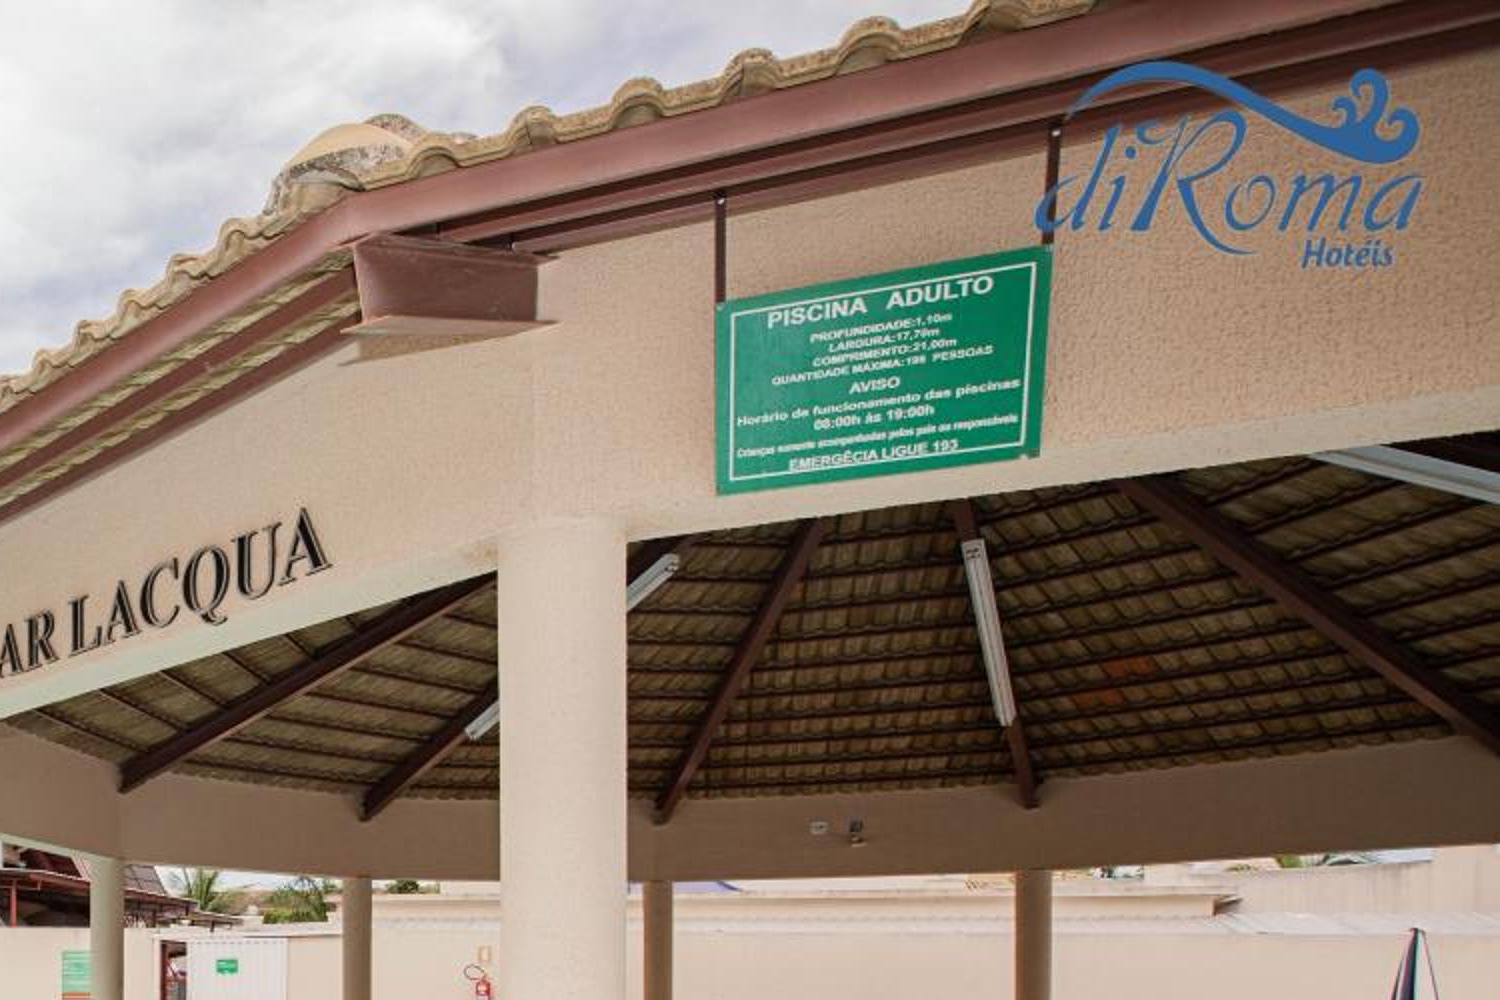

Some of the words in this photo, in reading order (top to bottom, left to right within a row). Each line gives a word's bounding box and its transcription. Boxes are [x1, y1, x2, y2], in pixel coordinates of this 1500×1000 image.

[768, 297, 867, 328] PISCINA
[886, 276, 994, 310] ADULTO
[772, 366, 850, 385] QUANTIDADE
[932, 345, 994, 363] PESSOAS
[850, 376, 900, 394] AVISO
[737, 412, 788, 427] Horário
[813, 392, 921, 415] funcionamento
[924, 388, 951, 400] das
[955, 378, 1021, 398] piscinas
[886, 404, 935, 421] 19:00h
[789, 448, 878, 473] EMERGÊCIA
[882, 441, 928, 460] LIGUE
[67, 506, 333, 658] LACQUA
